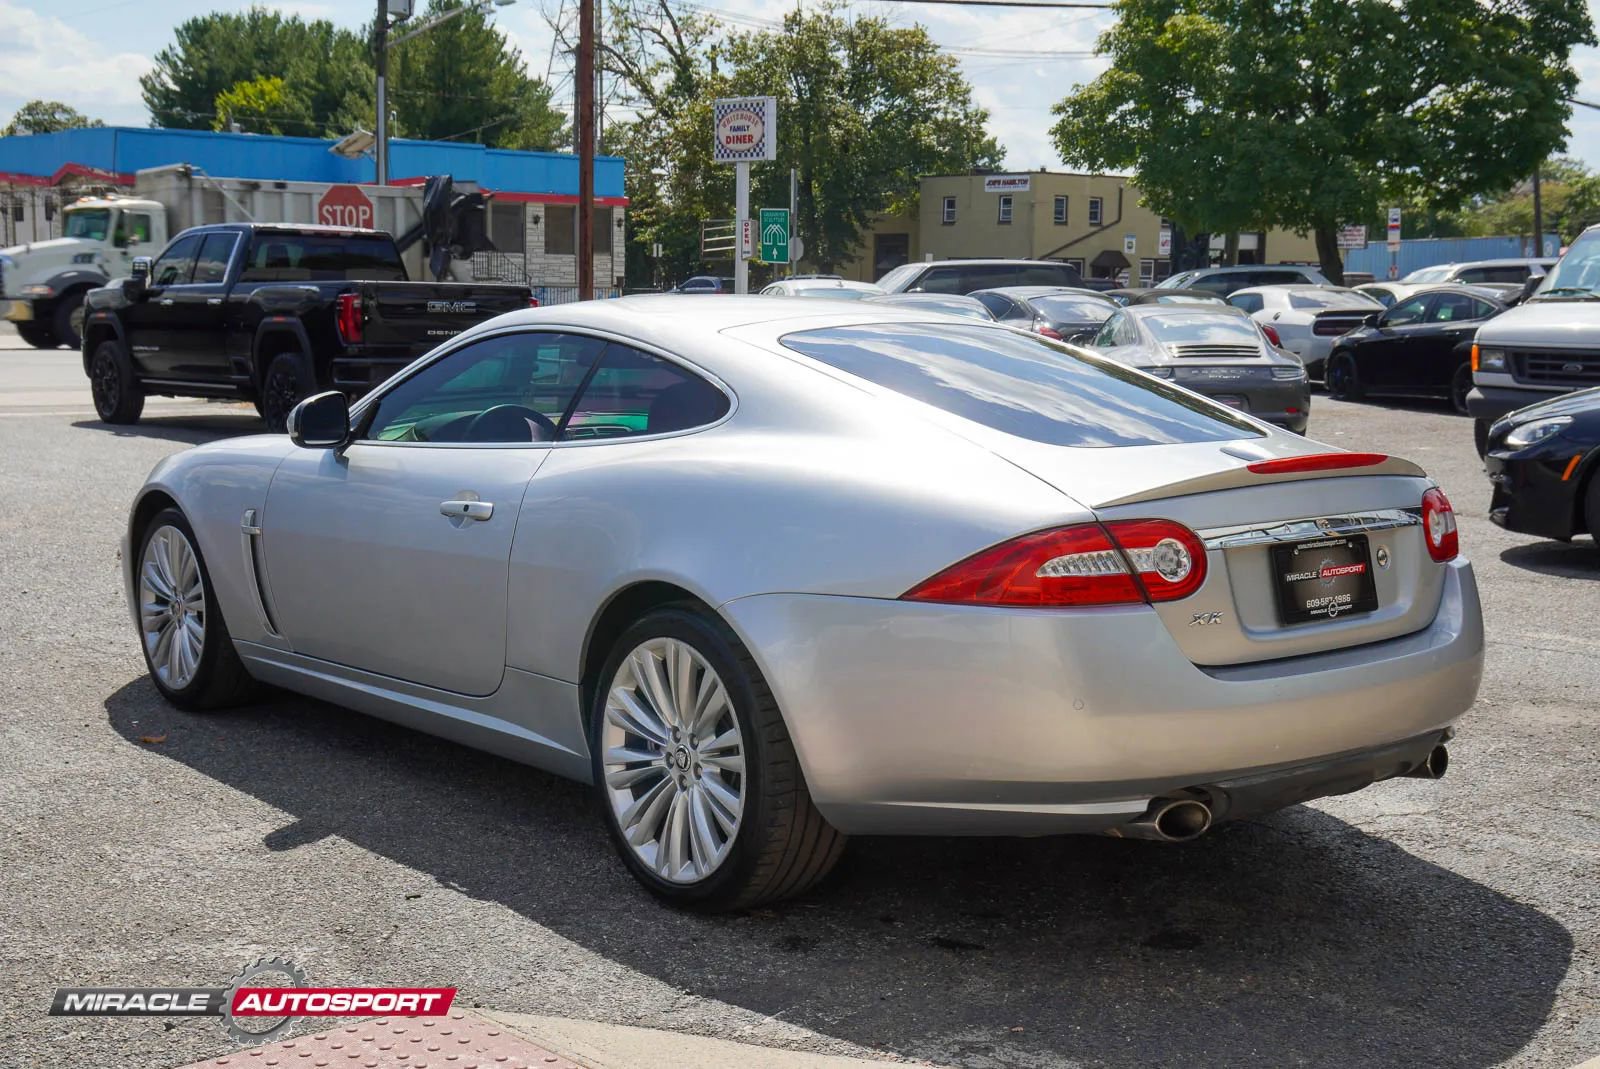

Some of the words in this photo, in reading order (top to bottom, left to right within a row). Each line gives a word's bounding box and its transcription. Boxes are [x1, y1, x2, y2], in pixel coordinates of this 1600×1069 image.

[726, 134, 753, 144] DINER
[322, 205, 370, 229] STOP
[427, 301, 476, 312] GMC
[1286, 571, 1317, 582] MIRACLE
[1322, 564, 1363, 577] AUTOSPORT
